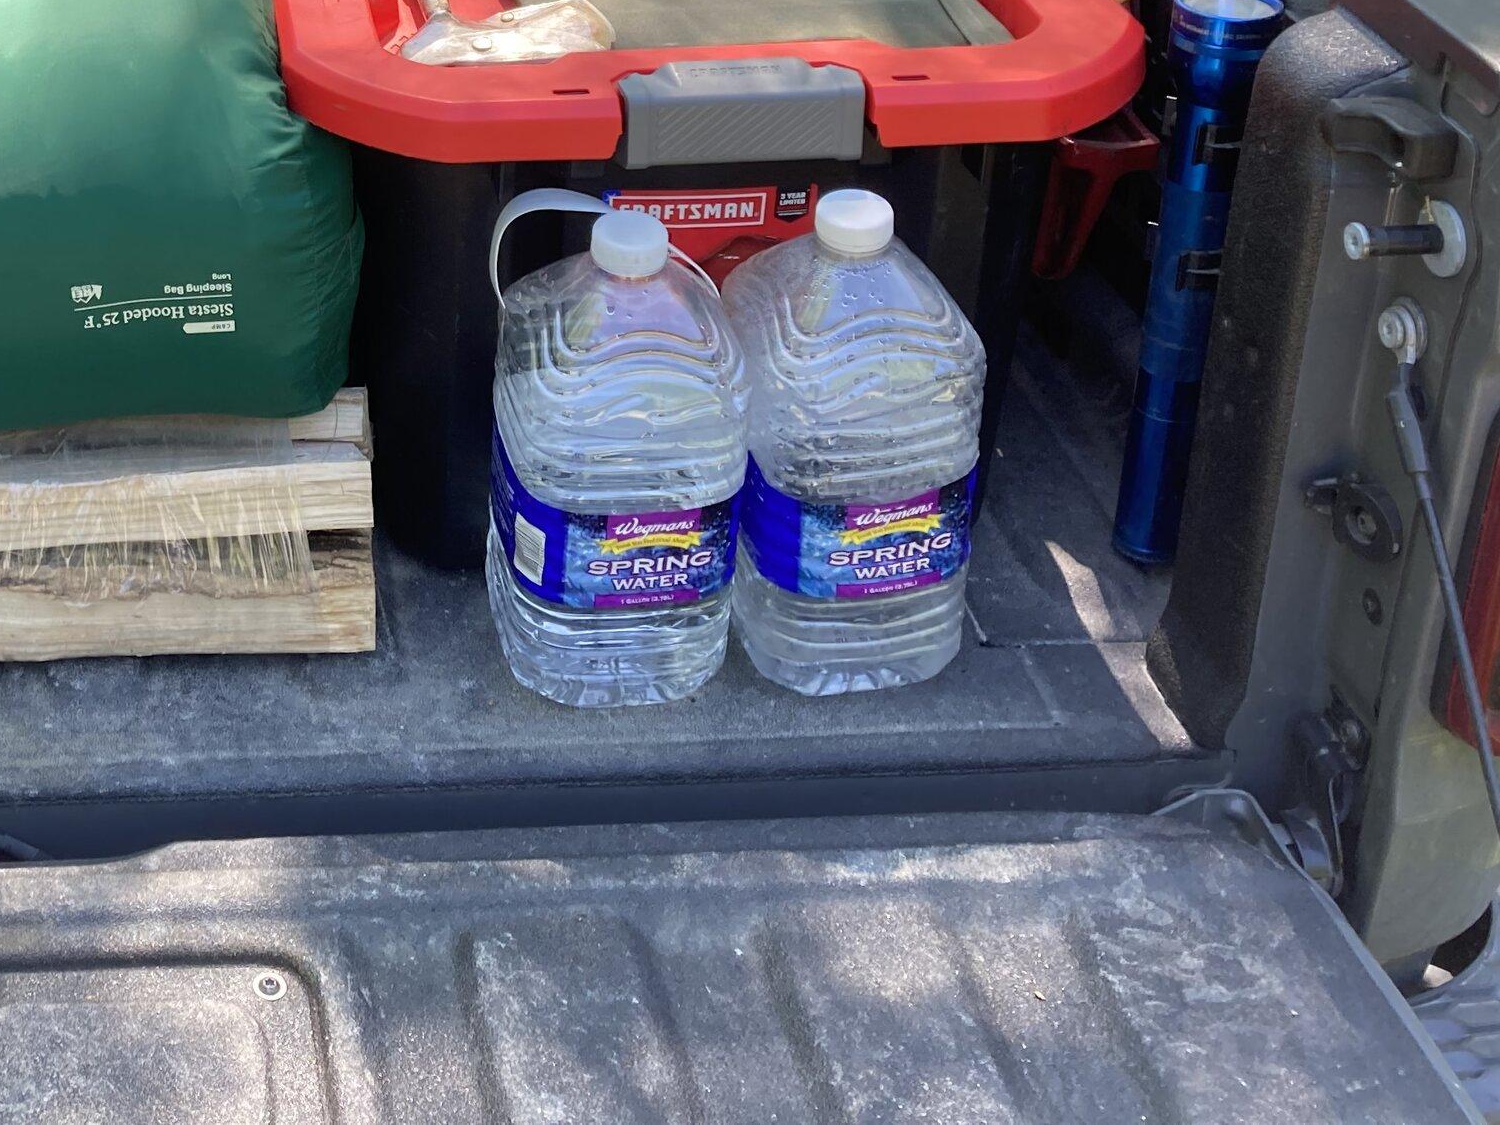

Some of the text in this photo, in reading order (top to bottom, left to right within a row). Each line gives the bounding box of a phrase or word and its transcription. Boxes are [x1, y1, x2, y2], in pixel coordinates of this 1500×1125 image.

[787, 191, 806, 199] YEAR
[164, 283, 232, 295] Sleeping Bag
[123, 306, 185, 324] Hooded
[188, 303, 234, 317] Siesta
[853, 502, 934, 526] Wegmans
[612, 518, 695, 539] Wegmans
[829, 532, 952, 566] SPRING
[588, 551, 712, 575] SPRING
[854, 557, 931, 580] WATER
[612, 573, 689, 591] WATER
